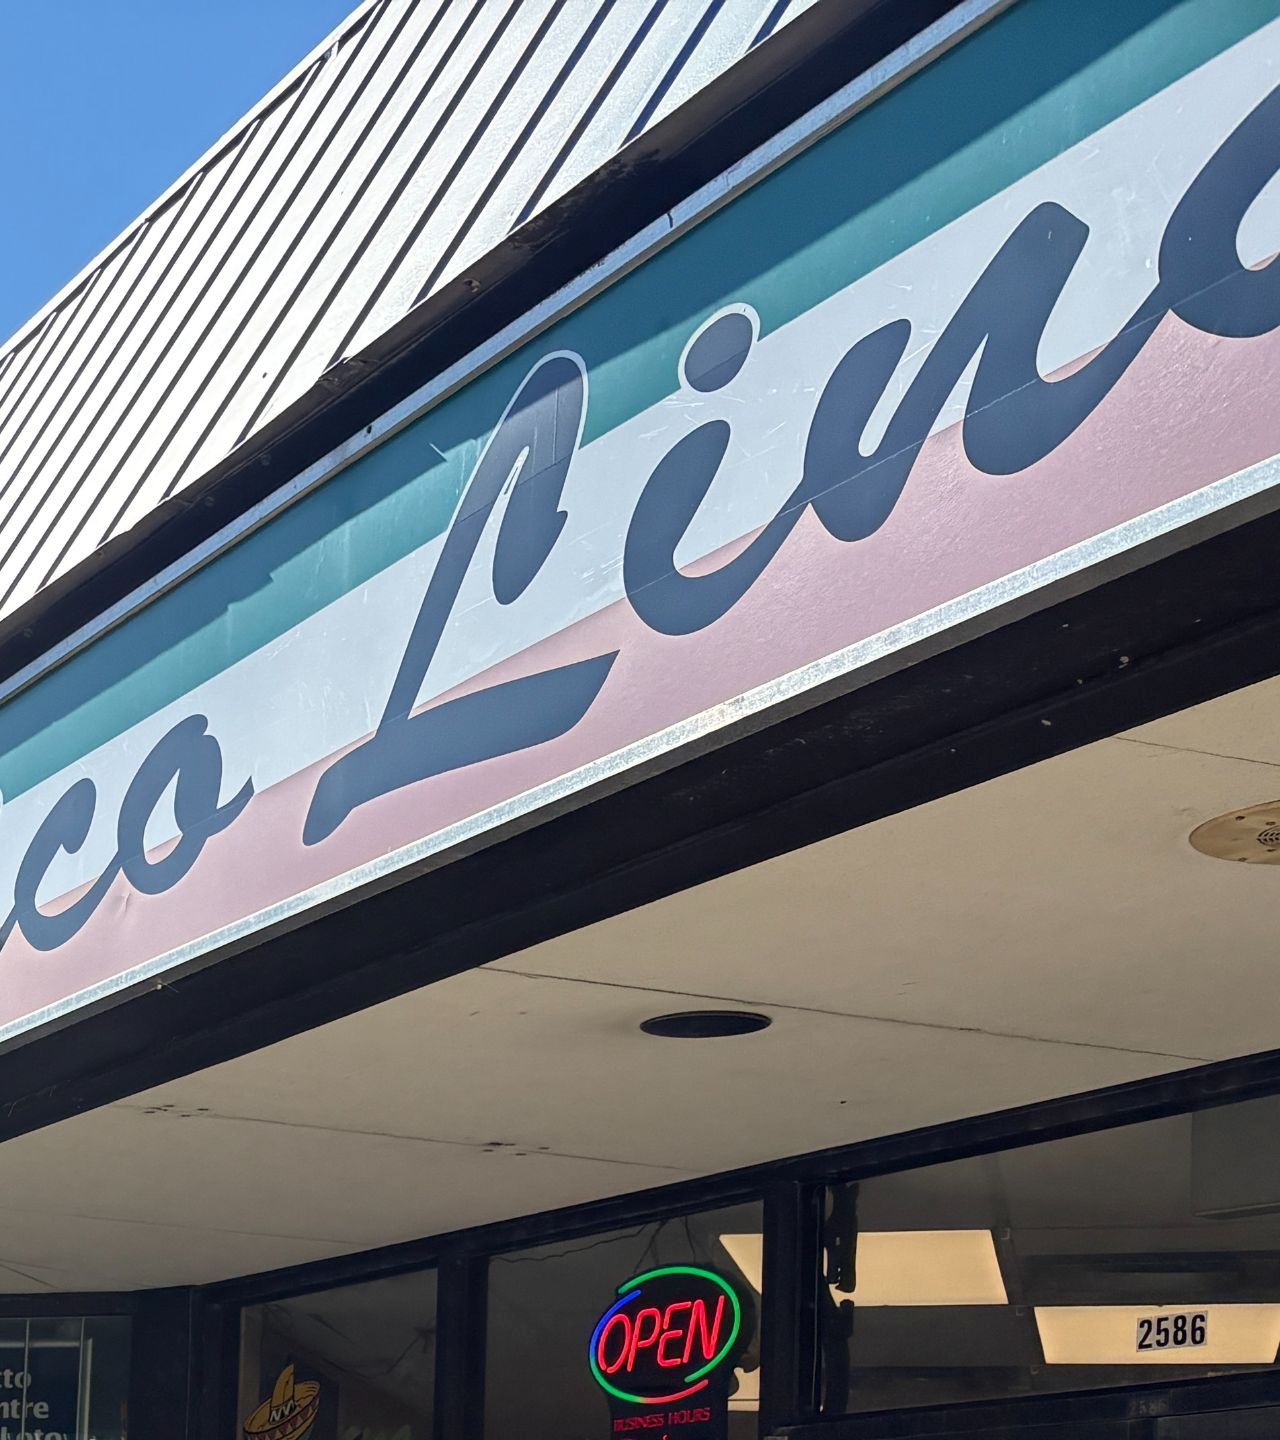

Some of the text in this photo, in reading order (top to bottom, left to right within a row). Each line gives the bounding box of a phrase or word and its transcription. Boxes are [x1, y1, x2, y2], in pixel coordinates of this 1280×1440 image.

[599, 1296, 726, 1374] OPEN
[1139, 1313, 1207, 1349] 2586
[613, 1408, 711, 1432] BUSINESS HOURS
